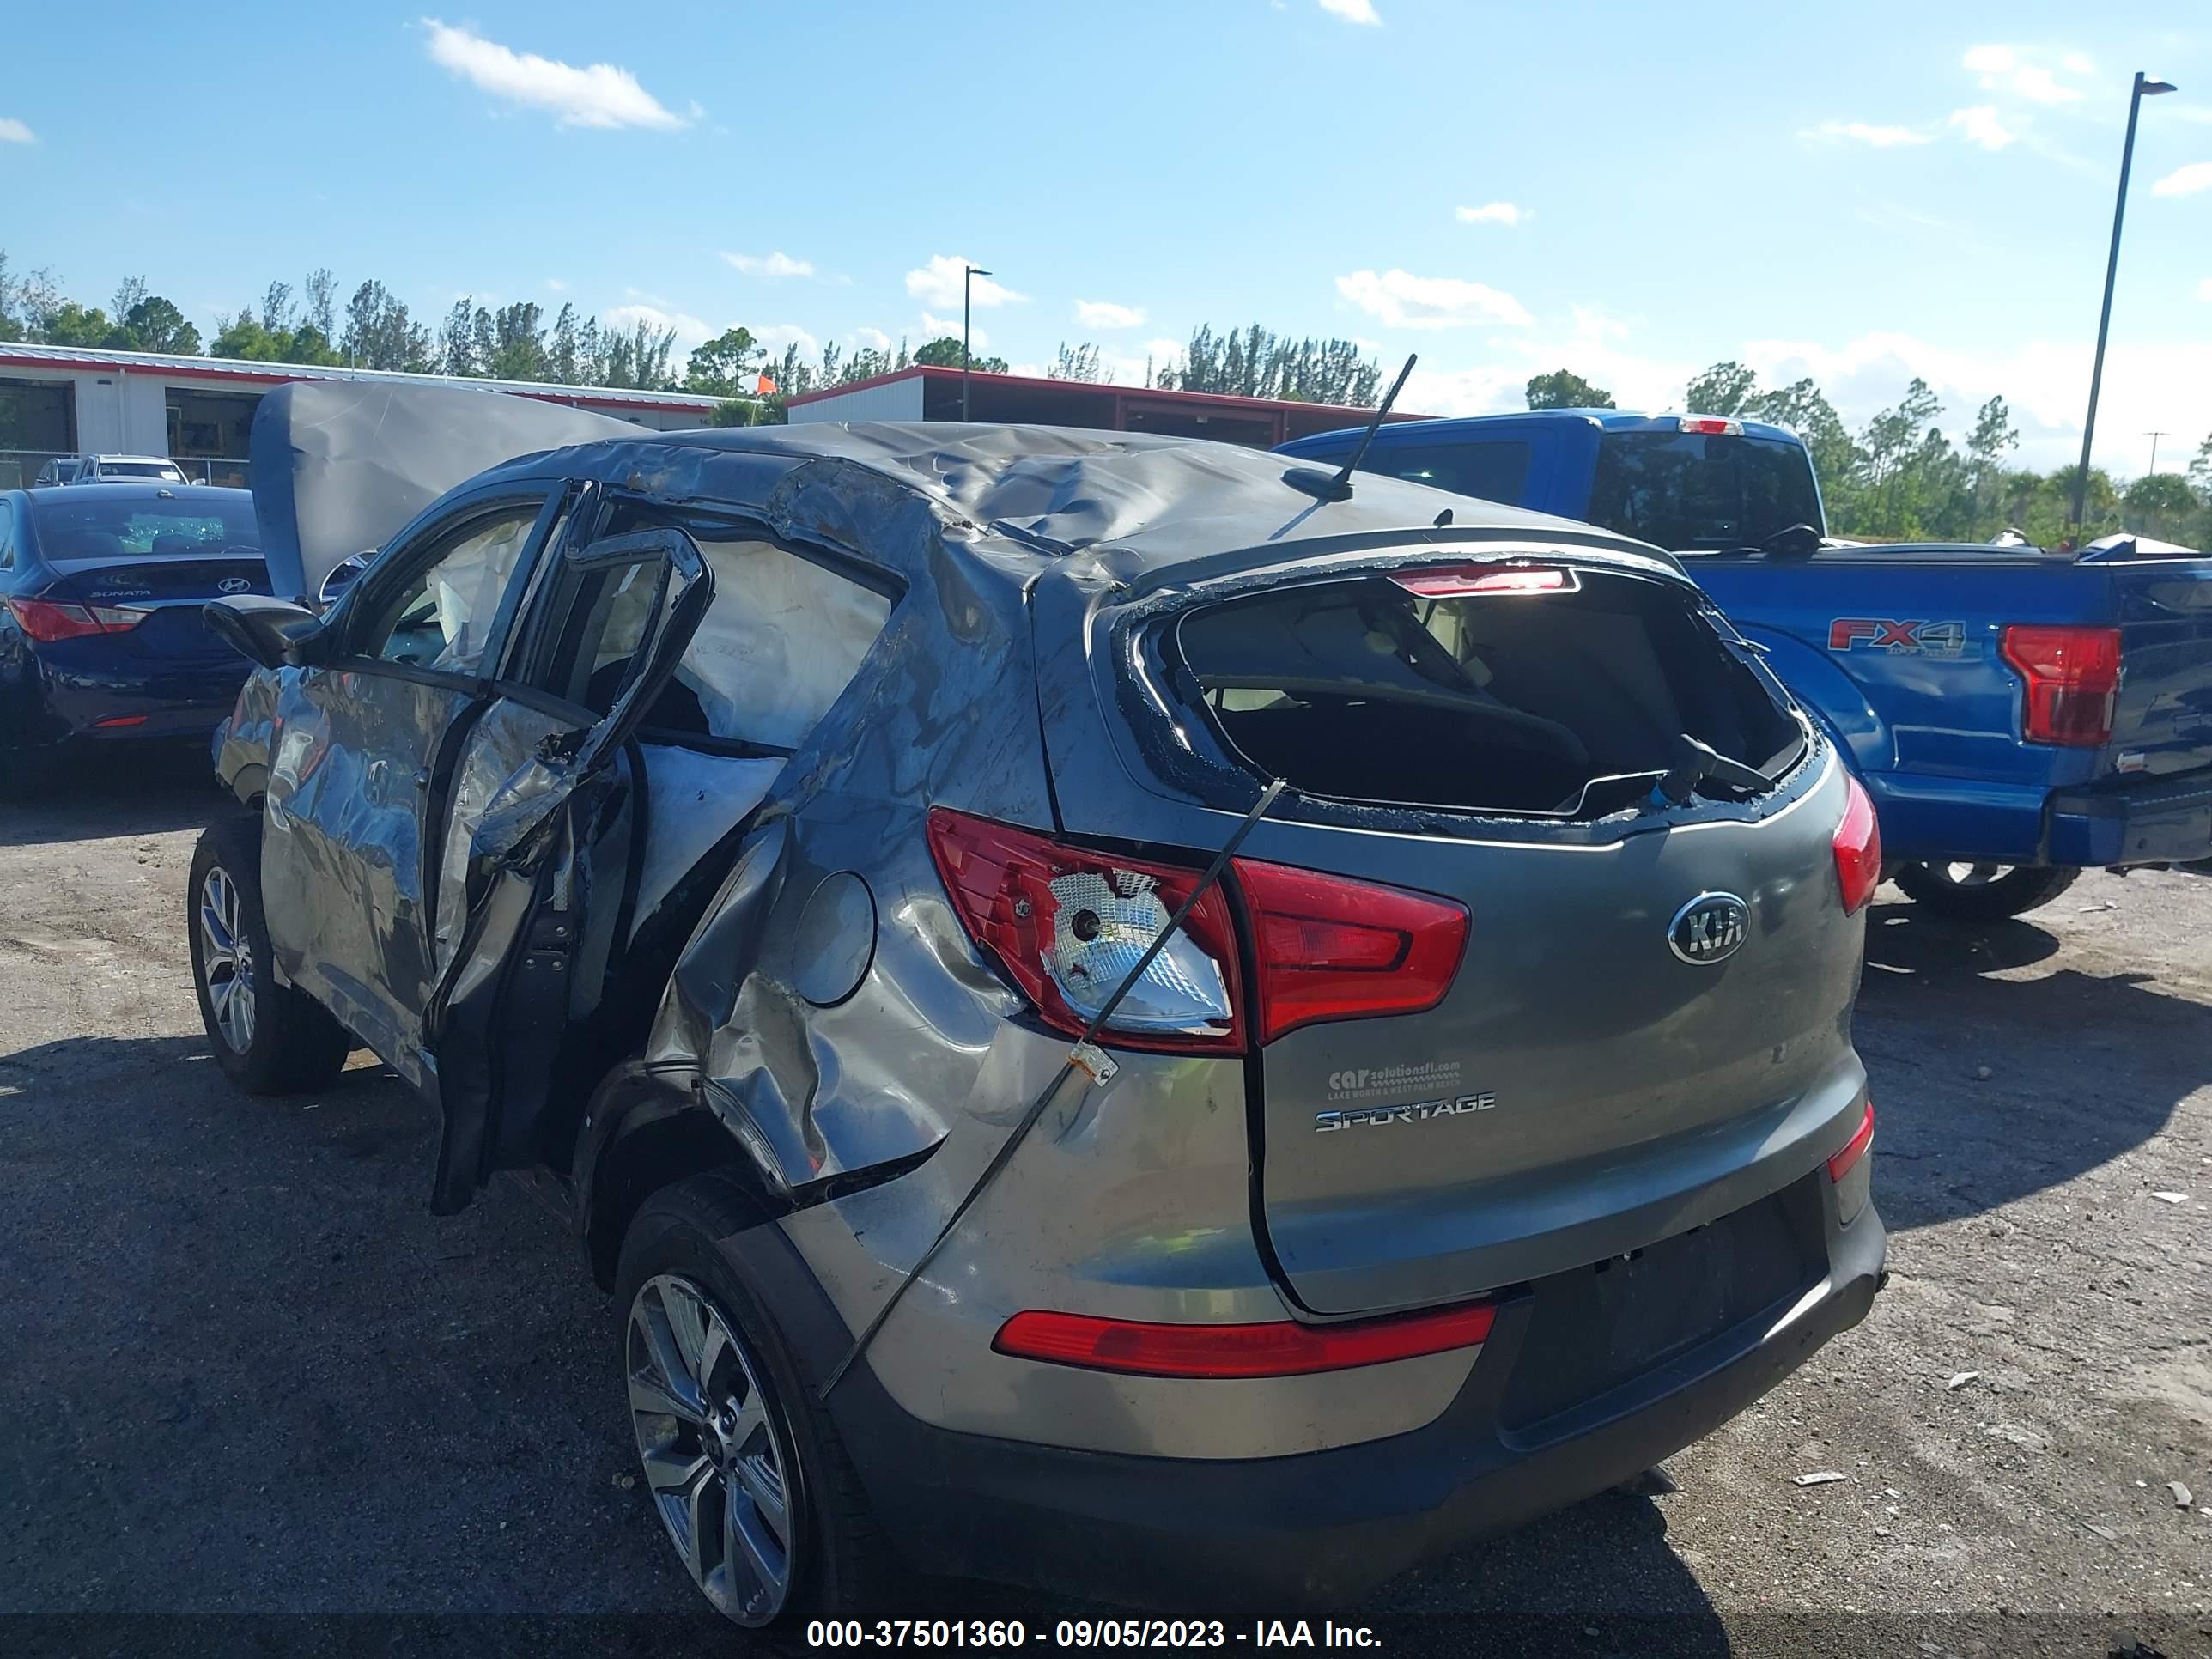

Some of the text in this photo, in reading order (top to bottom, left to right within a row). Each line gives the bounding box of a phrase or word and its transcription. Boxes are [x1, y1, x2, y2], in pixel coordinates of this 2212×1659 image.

[1827, 617, 1966, 652] FX4
[1688, 906, 1742, 952] KIA
[1328, 1068, 1370, 1091] car
[1328, 1091, 1351, 1100] LAKE
[1352, 1088, 1382, 1098] WORTH
[1390, 1085, 1412, 1095] WEST
[1413, 1082, 1434, 1092] PALM
[1315, 1091, 1497, 1132] SPORTAGE
